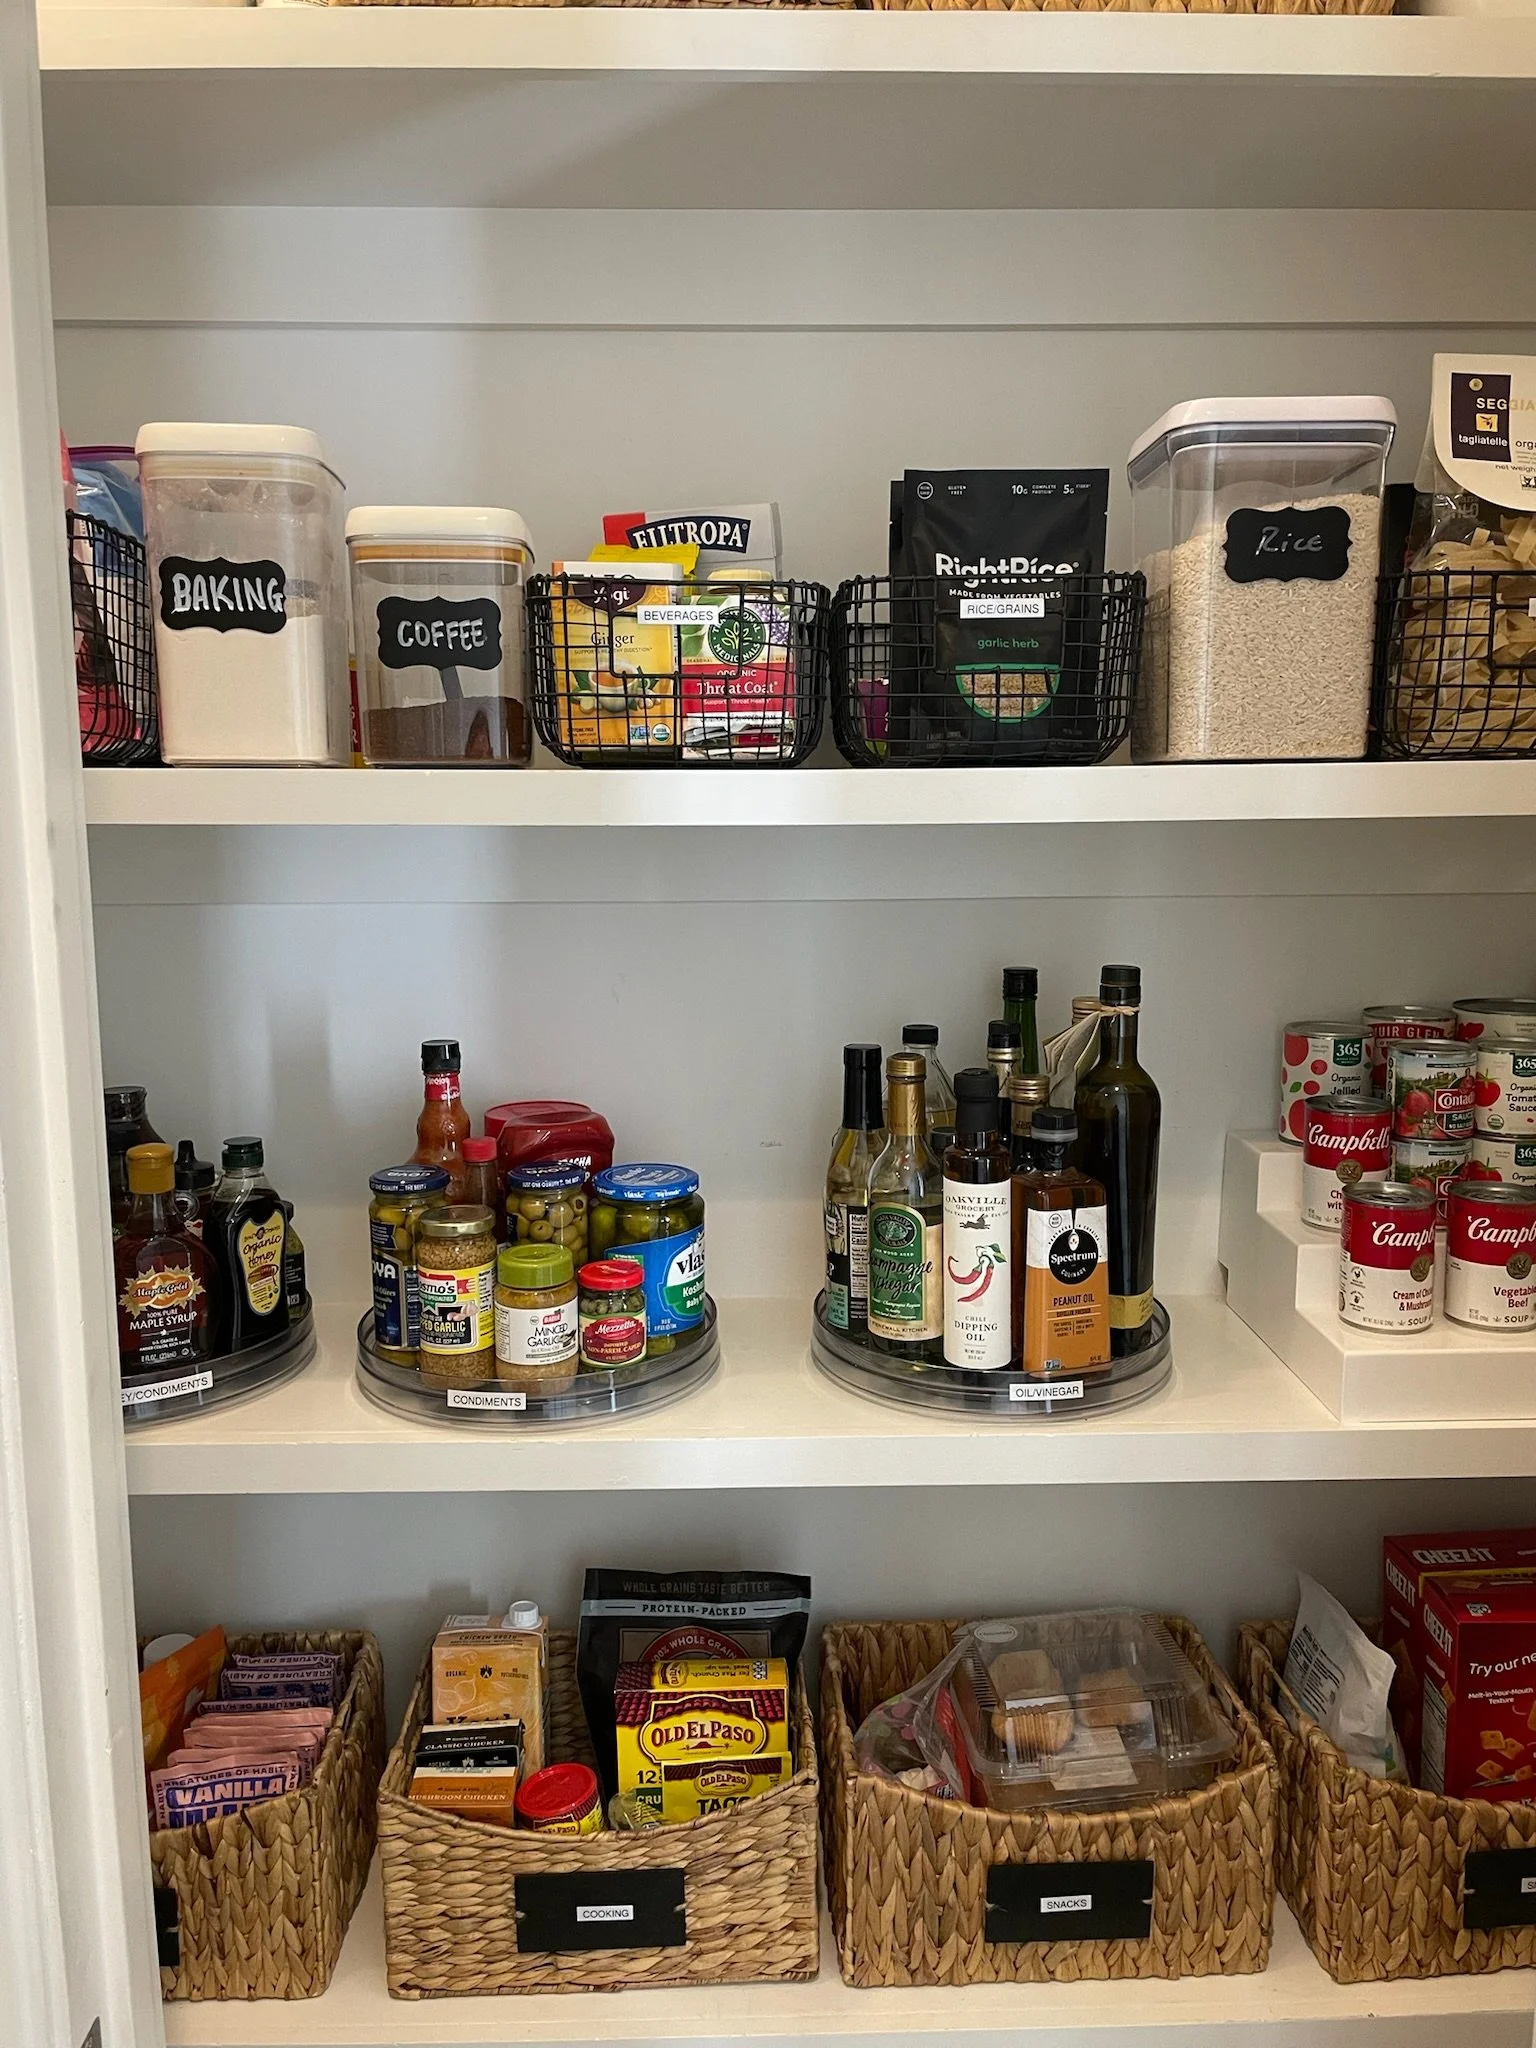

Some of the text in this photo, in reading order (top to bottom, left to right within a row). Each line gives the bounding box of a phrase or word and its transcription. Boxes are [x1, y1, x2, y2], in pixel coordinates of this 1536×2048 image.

[1458, 434, 1508, 447] tagliatelle
[1011, 484, 1028, 495] 10G
[1062, 484, 1075, 494] 5G
[1254, 526, 1324, 556] Rice
[171, 573, 285, 614] BAKING
[949, 588, 1061, 600] MADE FROM VEGETABLES
[643, 610, 714, 621] BEVERAGES
[967, 603, 1040, 615] RICE/GRAINS
[396, 617, 486, 651] COFFEE
[977, 637, 1039, 650] garlic herb
[713, 642, 761, 662] MEDICNALS
[717, 669, 757, 677] ORGNIC
[1335, 1042, 1361, 1057] 365
[1515, 1058, 1536, 1070] 365
[1331, 1072, 1361, 1084] Organic
[1330, 1086, 1361, 1095] Jellied
[1517, 1148, 1536, 1159] 365
[945, 1196, 1008, 1205] OAKVILLE
[955, 1204, 996, 1212] GROCERY
[242, 1235, 282, 1256] Organic
[248, 1249, 277, 1268] Honey
[1050, 1252, 1097, 1265] Spectrum
[133, 1281, 188, 1298] Maple Gold
[420, 1281, 455, 1294] smo's
[1053, 1293, 1095, 1307] PEANUT OIL
[1393, 1290, 1415, 1300] Cream
[1399, 1302, 1405, 1311] &
[1508, 1298, 1528, 1308] Beef
[146, 1308, 178, 1319] 100% PURE
[1504, 1315, 1529, 1323] SOUP
[129, 1310, 198, 1331] MAPLE SYRUP
[434, 1320, 466, 1333] GARLIC
[594, 1319, 637, 1335] Mezzetta
[954, 1320, 998, 1332] DIPPING
[1407, 1316, 1428, 1326] SOUP
[534, 1323, 569, 1337] MINCED
[966, 1333, 985, 1342] OIL
[1015, 1386, 1080, 1398] OIL/VINEGAR
[452, 1394, 522, 1407] CONDIMENTS
[1412, 1547, 1496, 1564] CHEEZ-IT
[623, 1581, 770, 1595] WHOLE GRAINS TASTE BETTER
[1385, 1557, 1416, 1608] CHEEZ-IT
[642, 1603, 747, 1616] PROTEIN-PACKED
[1423, 1603, 1454, 1658] CHEEZ-IT
[669, 1635, 705, 1649] WHOLE
[1469, 1662, 1493, 1677] Try
[1494, 1658, 1519, 1673] our
[256, 1672, 270, 1680] OF
[1467, 1686, 1534, 1700] Melt-in-Your-Mouth
[239, 1703, 254, 1711] OF
[1488, 1696, 1515, 1705] Texture
[651, 1726, 685, 1748] OLD
[686, 1721, 709, 1740] EL
[424, 1739, 505, 1751] CLASSIC CHICKEN
[163, 1766, 285, 1788] KREATURES OF HABIT
[636, 1770, 658, 1784] 12
[700, 1775, 716, 1787] OLD
[716, 1774, 726, 1784] EL
[175, 1778, 284, 1806] VANILLA
[1046, 1899, 1088, 1910] SNACKS
[582, 1909, 629, 1919] COOKING
